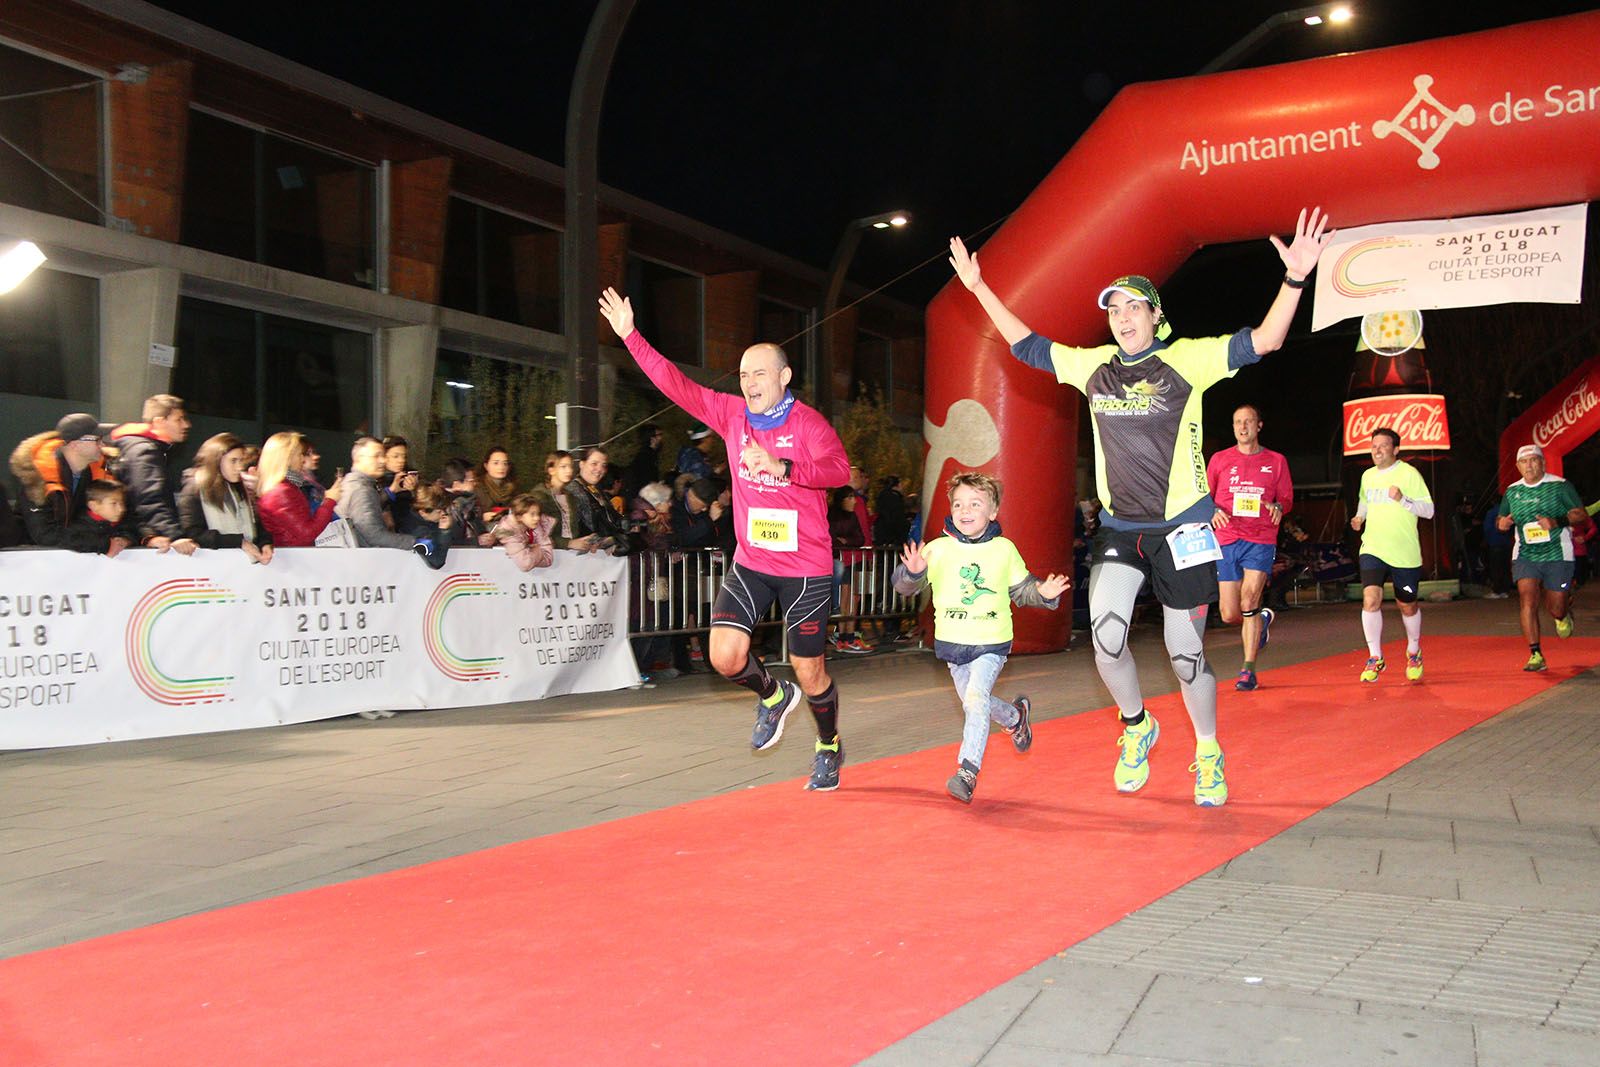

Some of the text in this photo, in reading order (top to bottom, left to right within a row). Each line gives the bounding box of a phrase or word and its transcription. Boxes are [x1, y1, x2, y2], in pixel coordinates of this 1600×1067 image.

[1179, 121, 1362, 176] Ajuntament
[1489, 91, 1534, 126] de
[1435, 225, 1561, 247] SANT CUGAT
[1462, 240, 1528, 255] 2018
[1428, 251, 1562, 271] CIUTAT EUROPEA
[1443, 265, 1544, 282] DE L'ESPORT
[761, 530, 779, 540] 430
[263, 585, 396, 608] SANT CUGAT
[518, 580, 617, 600] SANT CUGAT
[297, 611, 367, 633] 2018
[544, 602, 598, 621] 2018
[518, 622, 615, 645] CIUTAT EUROPEA
[258, 634, 401, 661] CIUTAT EUROPEA
[536, 644, 605, 666] DE L'ESPORT
[0, 651, 99, 679] UROPEA
[279, 660, 385, 686] DE L'ESPORT
